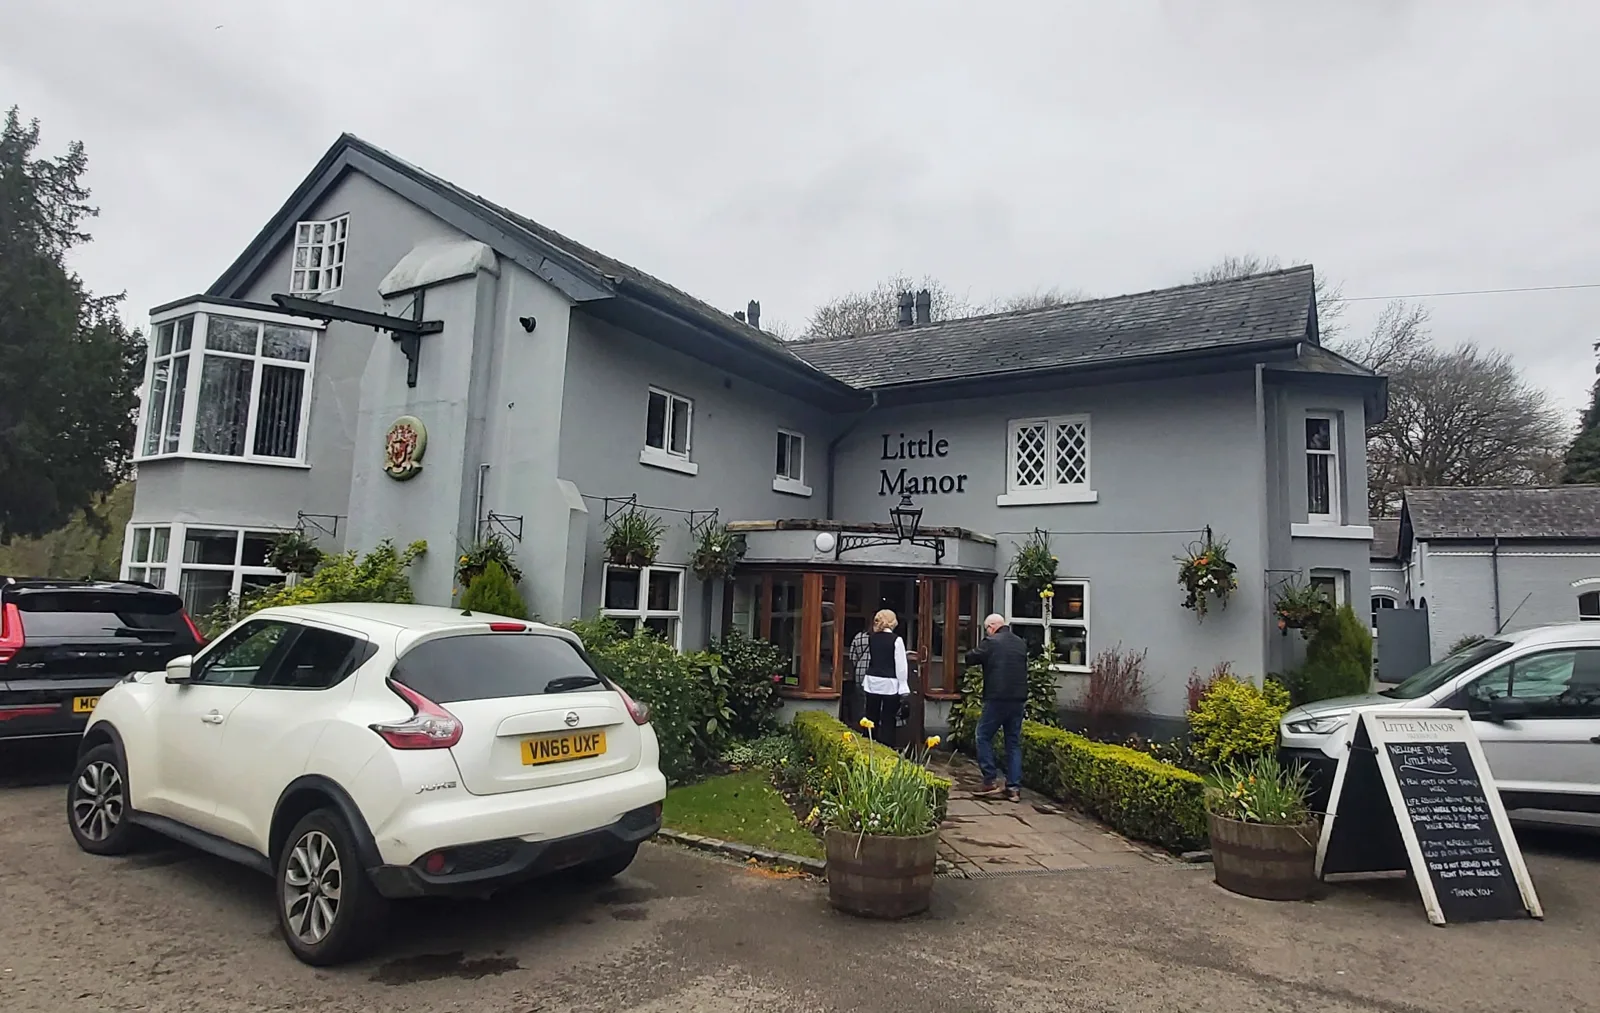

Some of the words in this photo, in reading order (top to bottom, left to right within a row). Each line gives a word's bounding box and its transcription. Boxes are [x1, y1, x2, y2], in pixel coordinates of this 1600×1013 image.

[881, 429, 949, 460] Little
[878, 468, 968, 496] Manor
[1382, 721, 1416, 732] LITTLE
[1417, 721, 1456, 732] MANOR
[530, 739, 570, 760] VN66
[573, 734, 600, 753] UXF
[1388, 745, 1424, 755] WELCOME
[1424, 746, 1434, 754] TO
[1435, 745, 1452, 755] THE
[1404, 755, 1427, 766] LITTLE
[416, 781, 457, 794] JUKE
[1429, 861, 1443, 870] FOOD
[1449, 861, 1460, 869] NOT
[1460, 860, 1480, 868] SERVED
